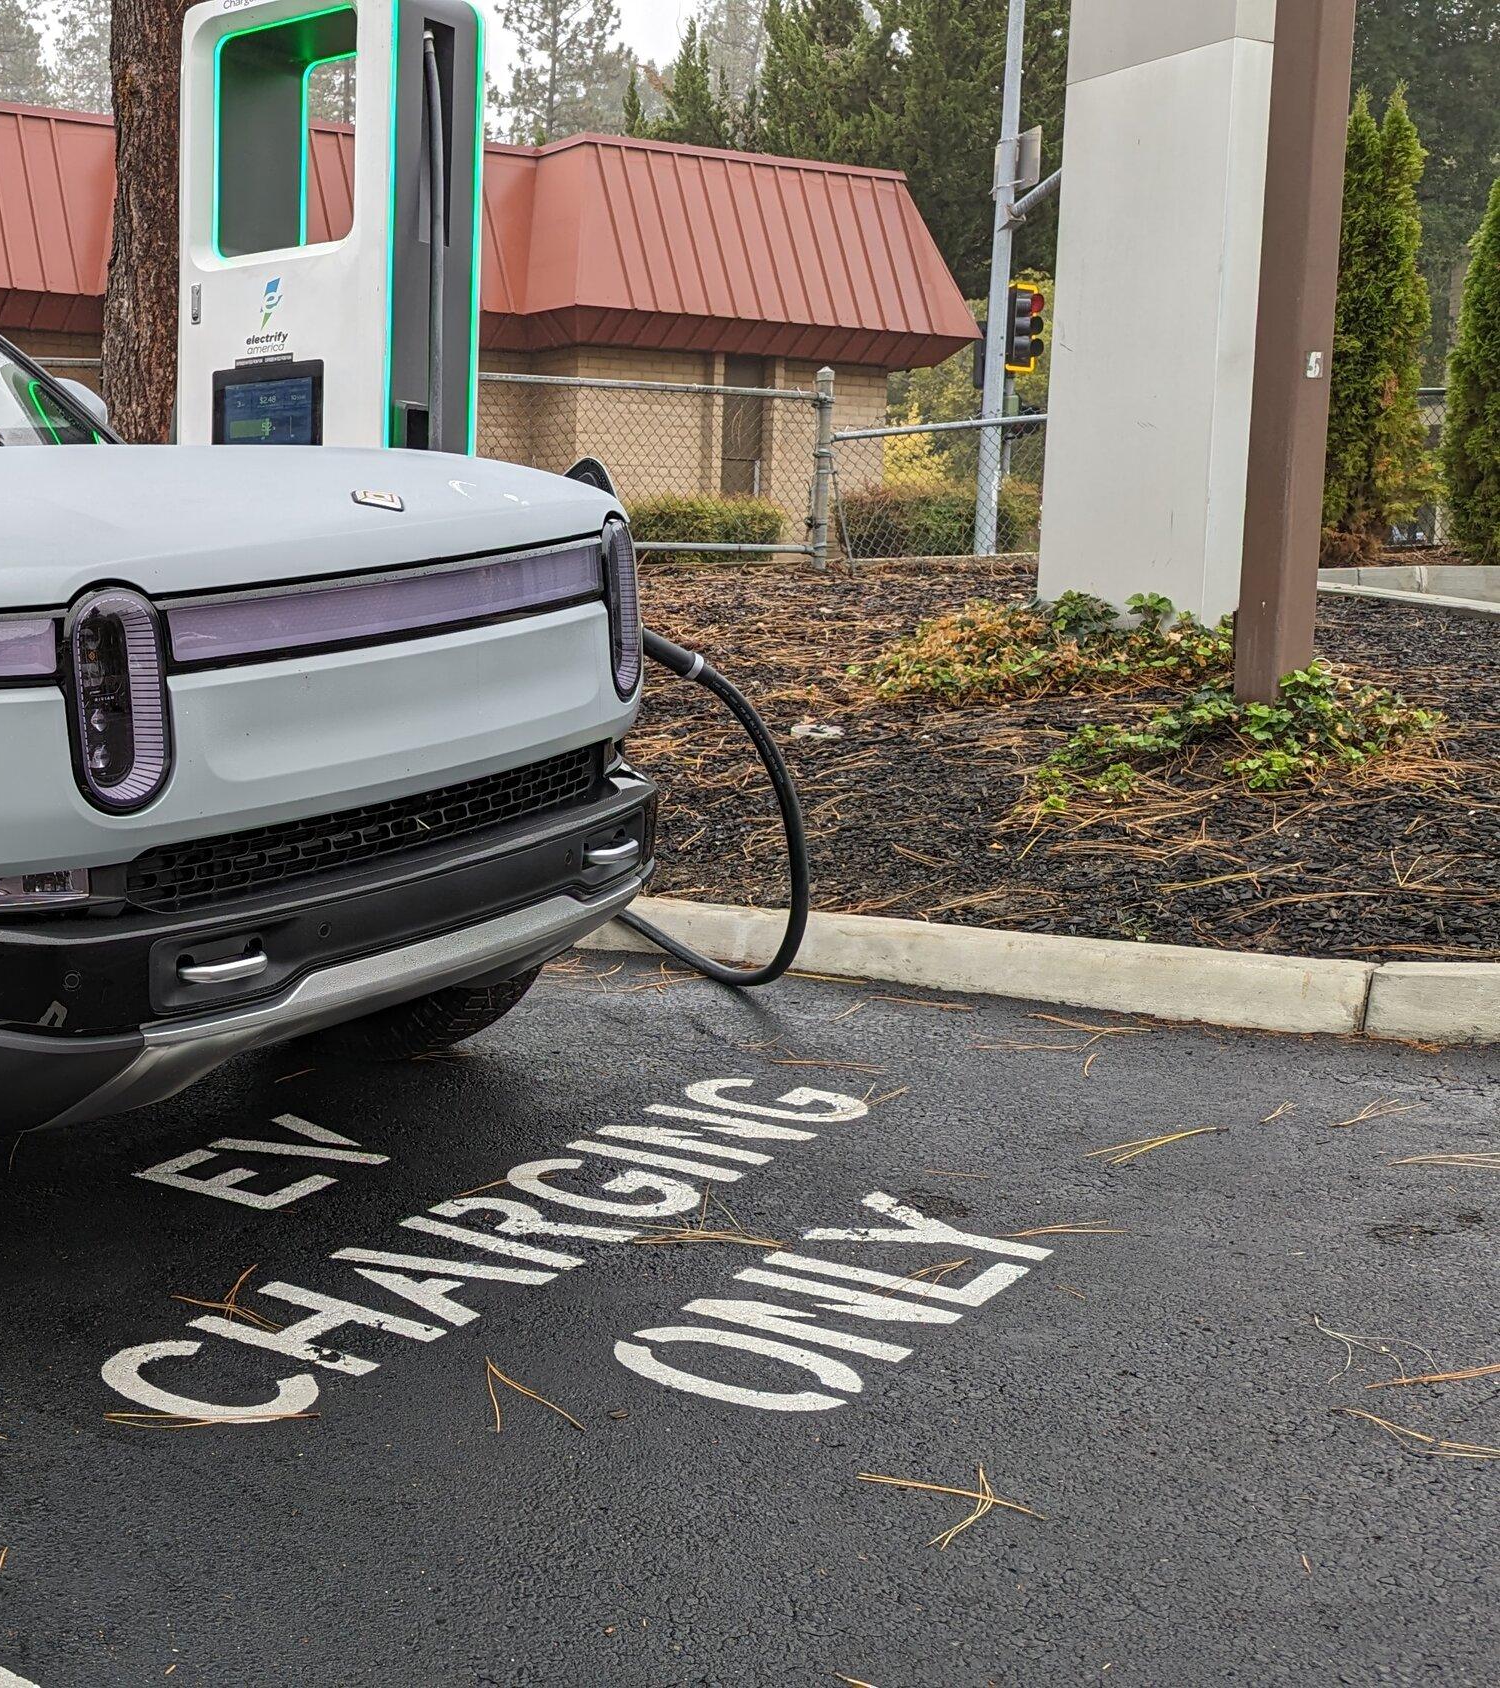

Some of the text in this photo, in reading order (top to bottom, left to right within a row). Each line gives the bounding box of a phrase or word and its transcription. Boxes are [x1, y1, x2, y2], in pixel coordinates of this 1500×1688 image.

[246, 331, 288, 345] electrify
[247, 343, 285, 355] america
[130, 1113, 390, 1210] EV
[101, 1078, 869, 1423] CHARGING
[613, 1191, 1054, 1412] ONLY
